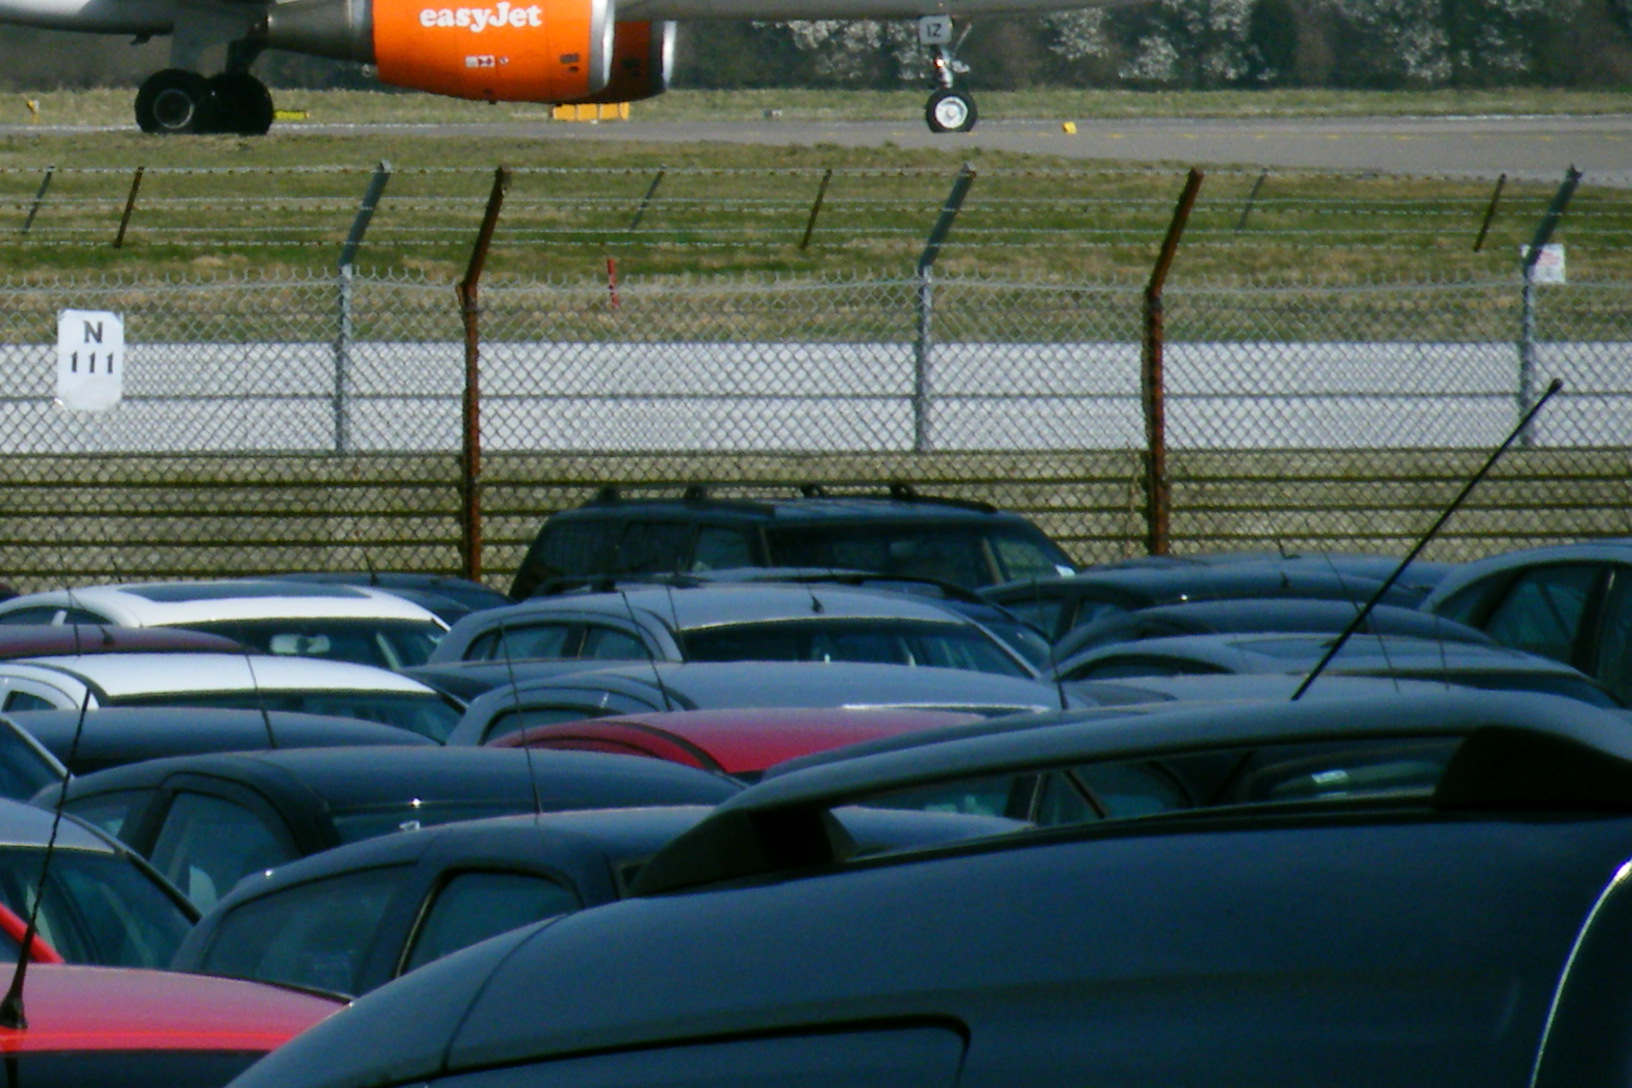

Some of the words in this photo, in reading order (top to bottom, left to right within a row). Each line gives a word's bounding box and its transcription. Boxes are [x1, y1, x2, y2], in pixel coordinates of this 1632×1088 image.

[419, 0, 544, 33] easyJet
[82, 320, 103, 344] N
[70, 350, 115, 374] 111
